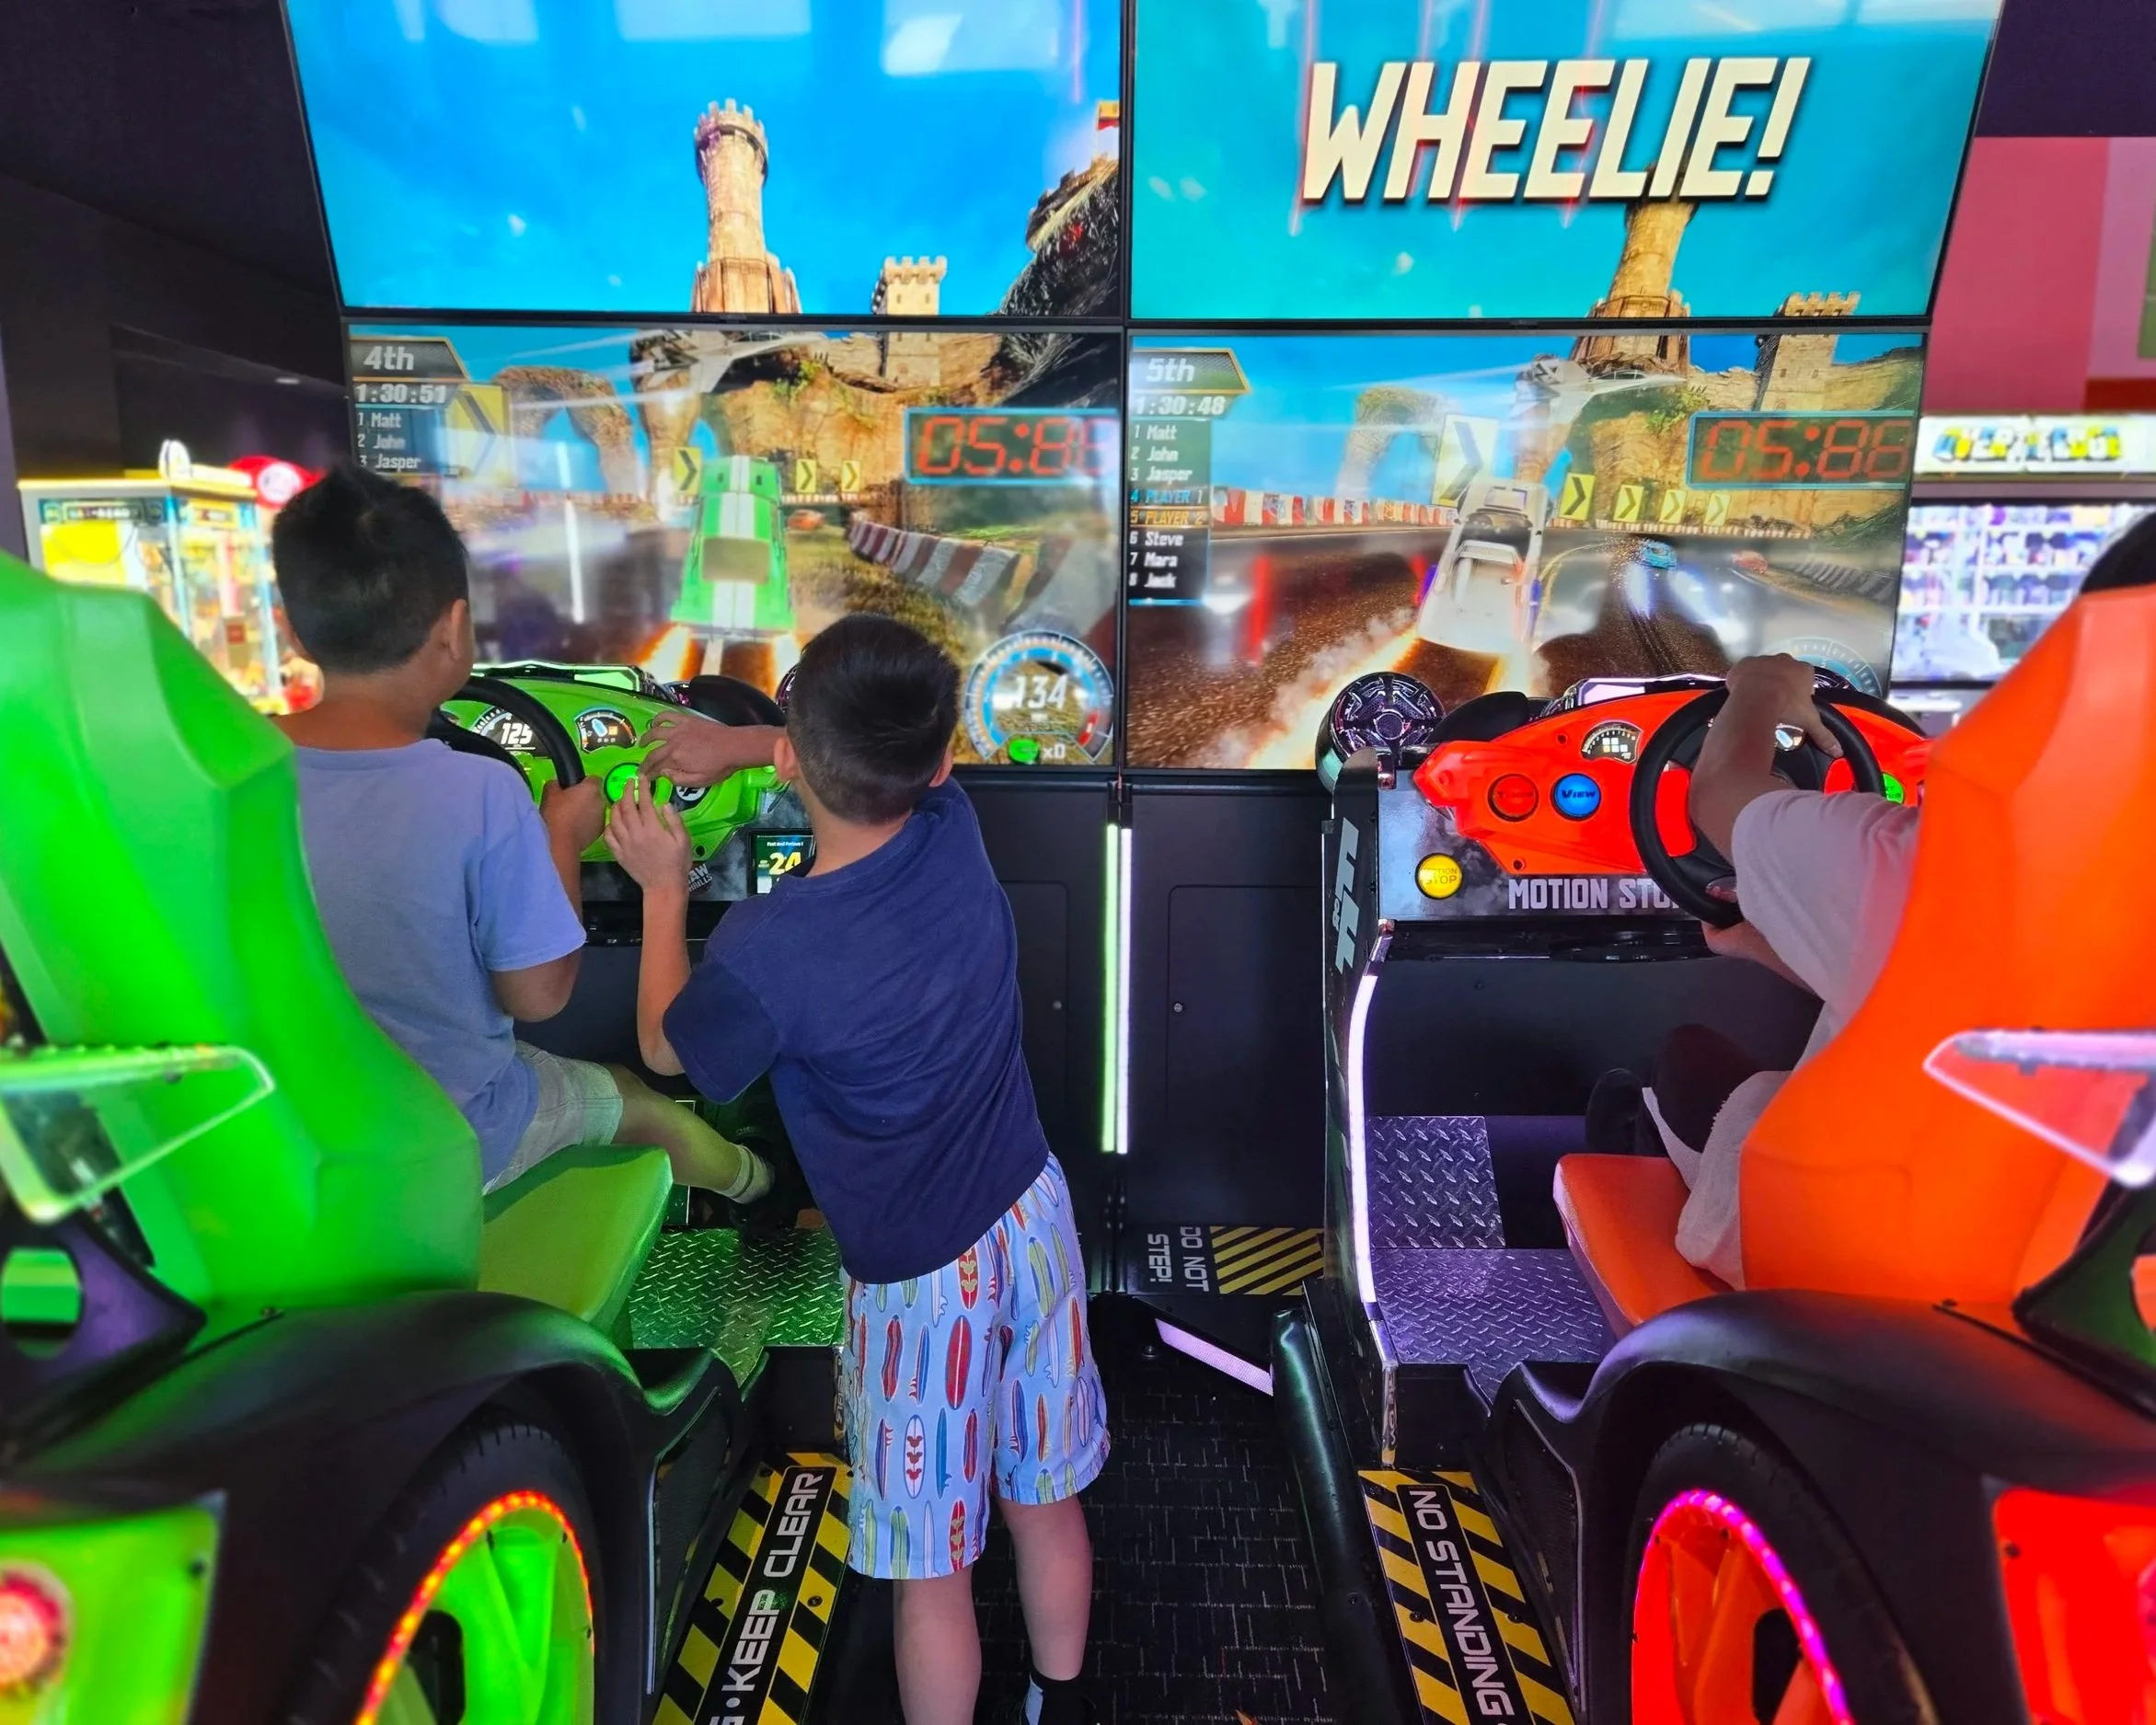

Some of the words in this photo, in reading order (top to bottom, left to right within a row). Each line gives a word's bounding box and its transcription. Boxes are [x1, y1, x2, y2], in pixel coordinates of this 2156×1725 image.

[1303, 57, 1812, 200] WHEELIE!
[363, 345, 414, 371] 4th
[1146, 358, 1195, 382] 5th
[355, 384, 447, 404] 1:30:51
[1136, 396, 1226, 416] 1:30:48
[358, 412, 363, 427] 1
[371, 412, 401, 428] Matt
[357, 433, 365, 447] 2
[373, 434, 406, 449] John
[1134, 425, 1139, 439] 1
[1147, 425, 1177, 441] Matt
[375, 453, 422, 472] Jasper
[1131, 446, 1139, 460] 2
[1147, 446, 1178, 462] John
[1130, 467, 1138, 481] 3
[1147, 466, 1193, 485] Jasper
[1130, 489, 1139, 502] 4
[1146, 489, 1191, 504] PLAYER
[1197, 489, 1204, 504] 1
[1130, 510, 1139, 523] 5
[1146, 510, 1190, 525] PLAYER
[1195, 511, 1204, 524] 2
[1129, 531, 1138, 545] 6
[1145, 531, 1183, 546] Steve
[1130, 552, 1138, 566] 7
[1015, 674, 1068, 708] 134
[500, 722, 533, 745] 125
[688, 863, 709, 884] AW
[1508, 879, 1608, 909] MOTION
[1619, 878, 1679, 909] STO
[1180, 1226, 1203, 1248] DO
[1147, 1234, 1172, 1282] STEP!
[1182, 1256, 1209, 1292] NOT
[1409, 1490, 1447, 1530] NO
[721, 1589, 780, 1691] KEEP
[763, 1473, 824, 1577] CLEAR
[1426, 1540, 1515, 1716] STANDING
